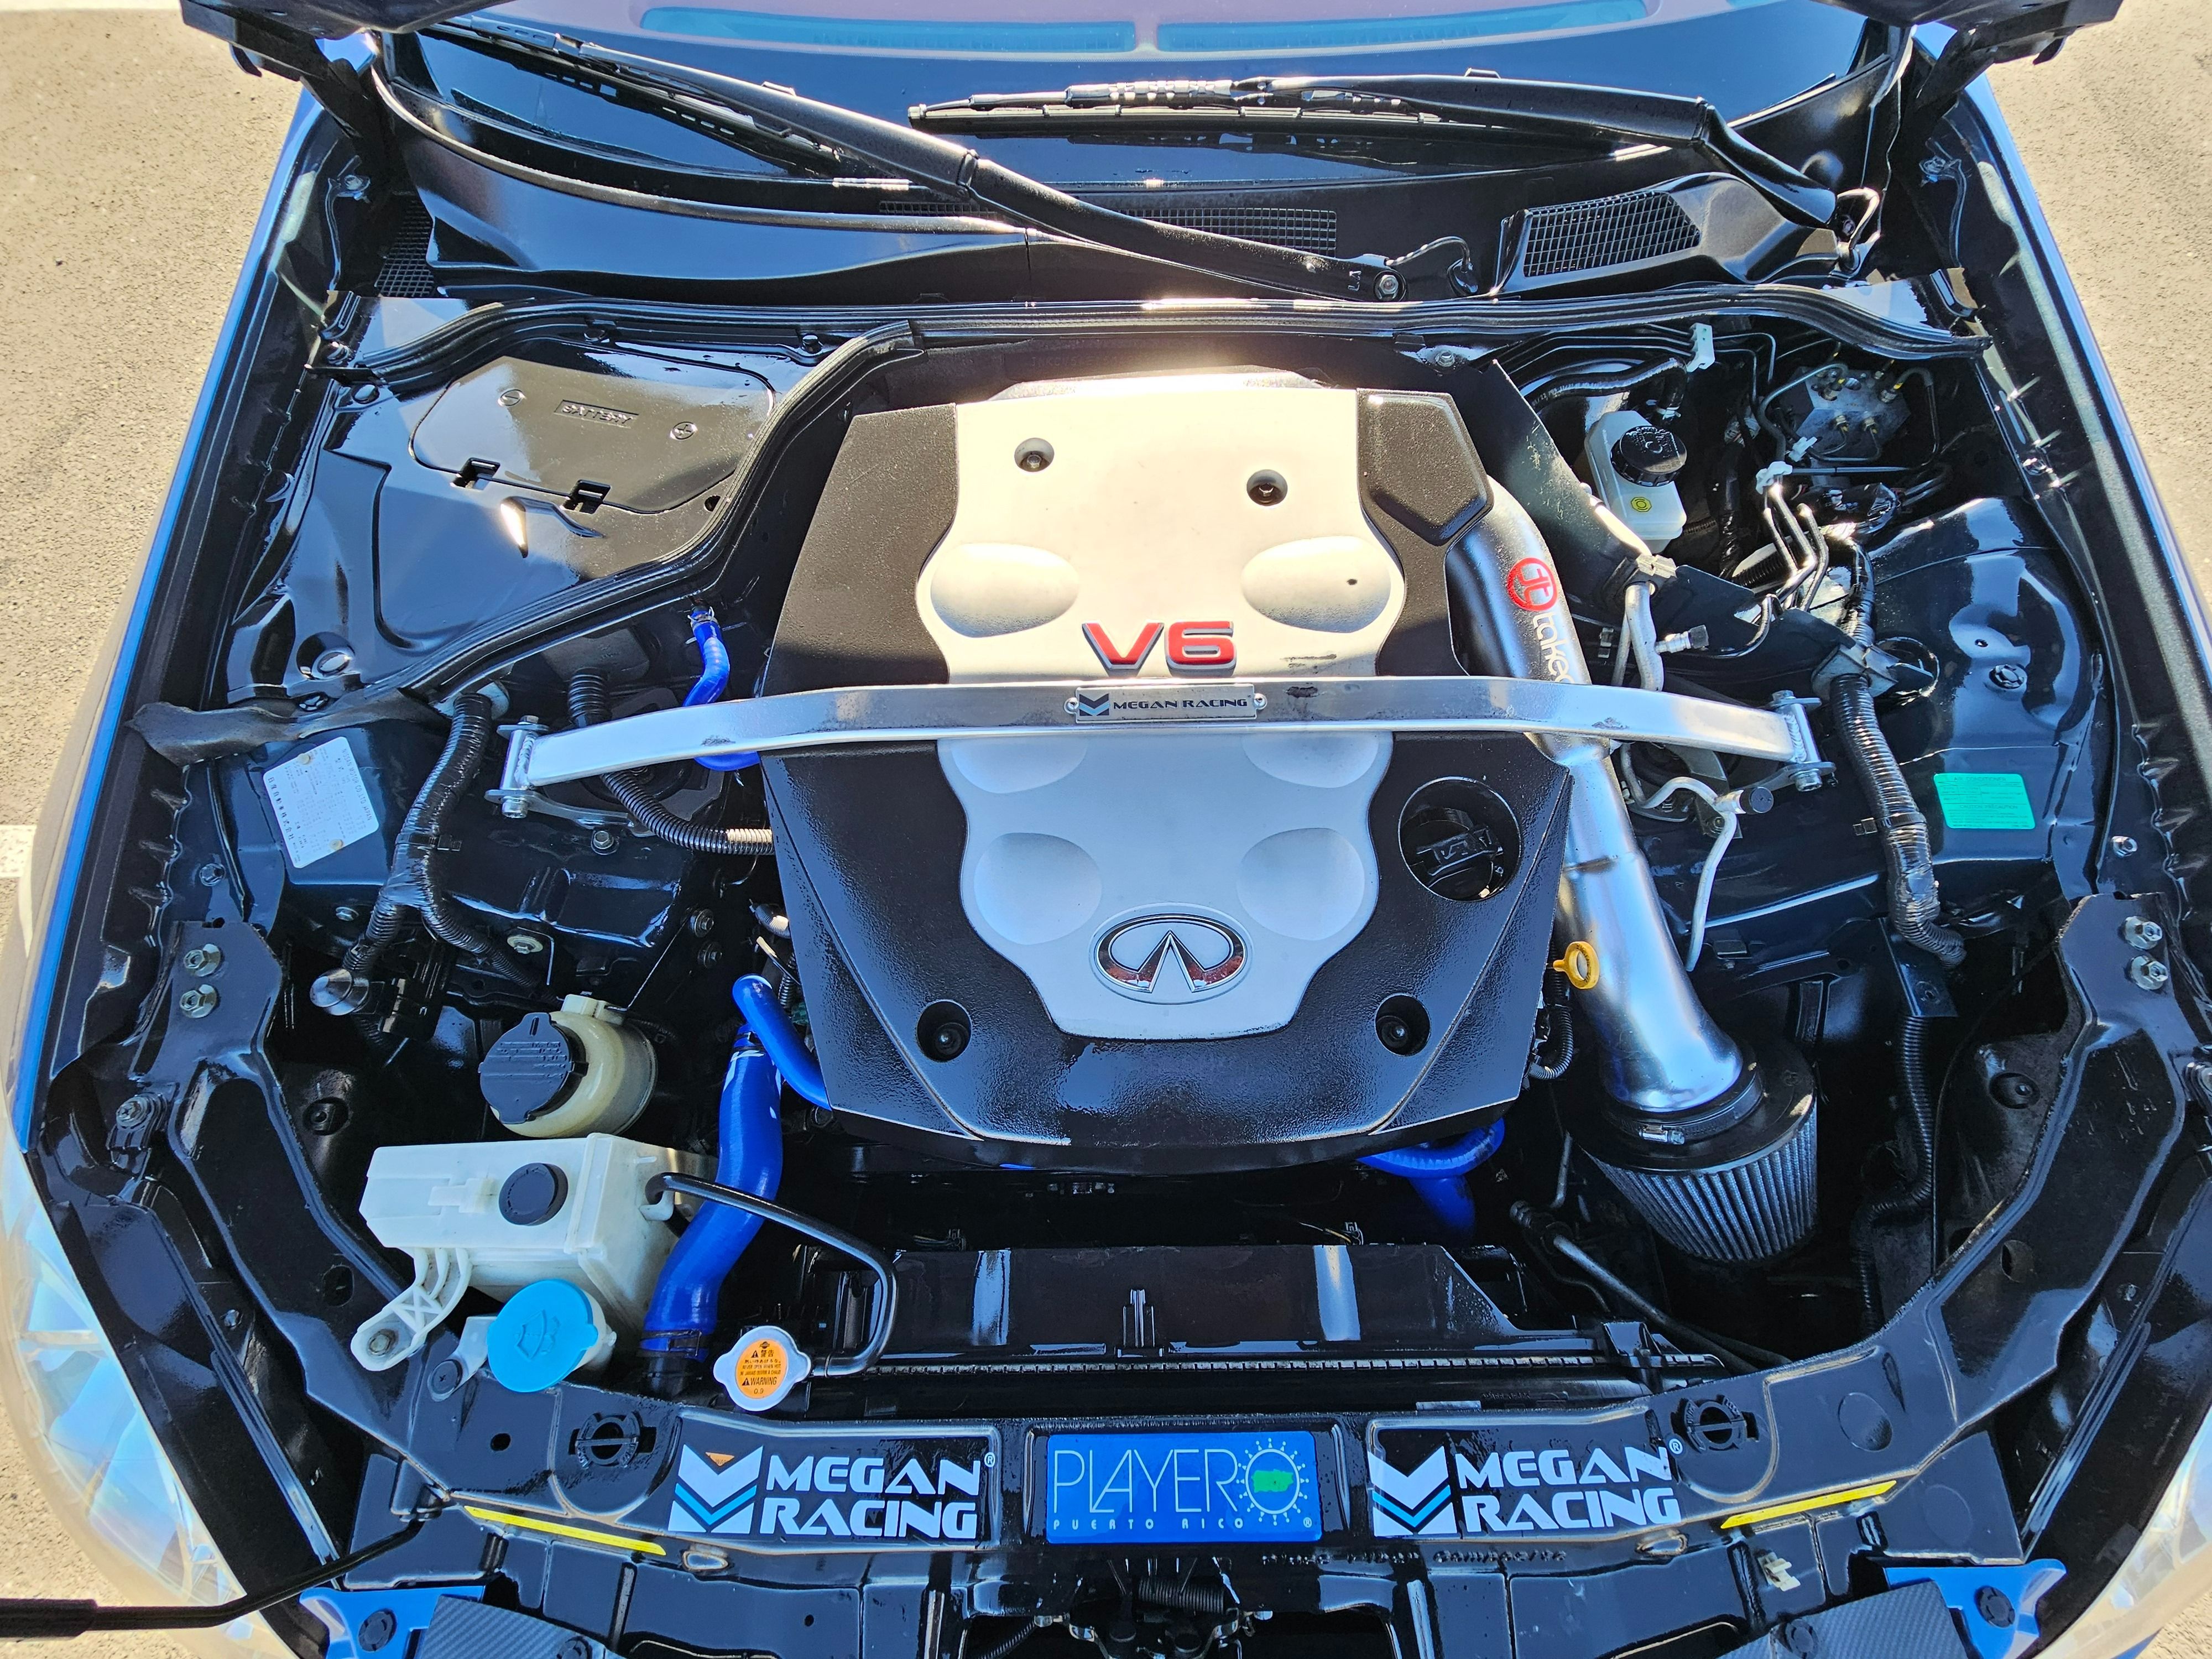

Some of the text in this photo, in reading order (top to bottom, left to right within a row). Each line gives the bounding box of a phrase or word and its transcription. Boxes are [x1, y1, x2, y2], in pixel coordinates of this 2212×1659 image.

[561, 404, 634, 425] BATTERY
[1082, 620, 1238, 674] V6
[1113, 698, 1248, 709] MEGAN RACING
[342, 748, 352, 766] NISSAN
[349, 768, 359, 784] MOTOR
[363, 806, 372, 821] JAPAN
[750, 1376, 778, 1386] WARNING
[766, 1455, 980, 1496] MEGAN
[1455, 1447, 1672, 1489] MEGAN
[760, 1497, 977, 1539] RACING
[1053, 1517, 1244, 1530] PUERTO RICO
[1462, 1487, 1682, 1532] RACING
